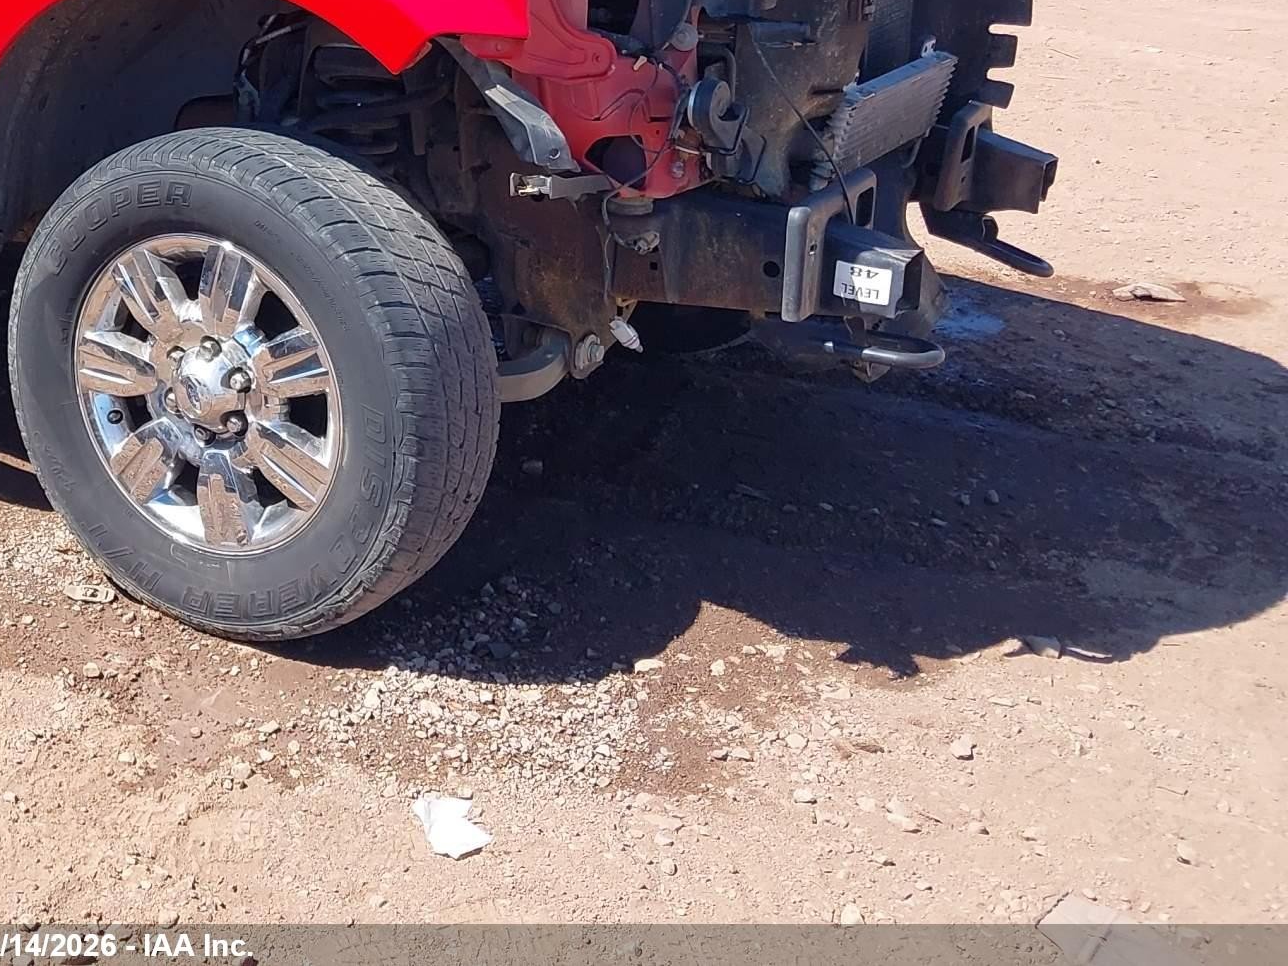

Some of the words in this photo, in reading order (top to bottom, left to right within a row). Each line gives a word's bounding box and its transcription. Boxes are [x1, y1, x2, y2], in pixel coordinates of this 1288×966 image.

[43, 179, 193, 275] COOPER
[849, 266, 880, 280] 48
[840, 282, 880, 300] LEVEL
